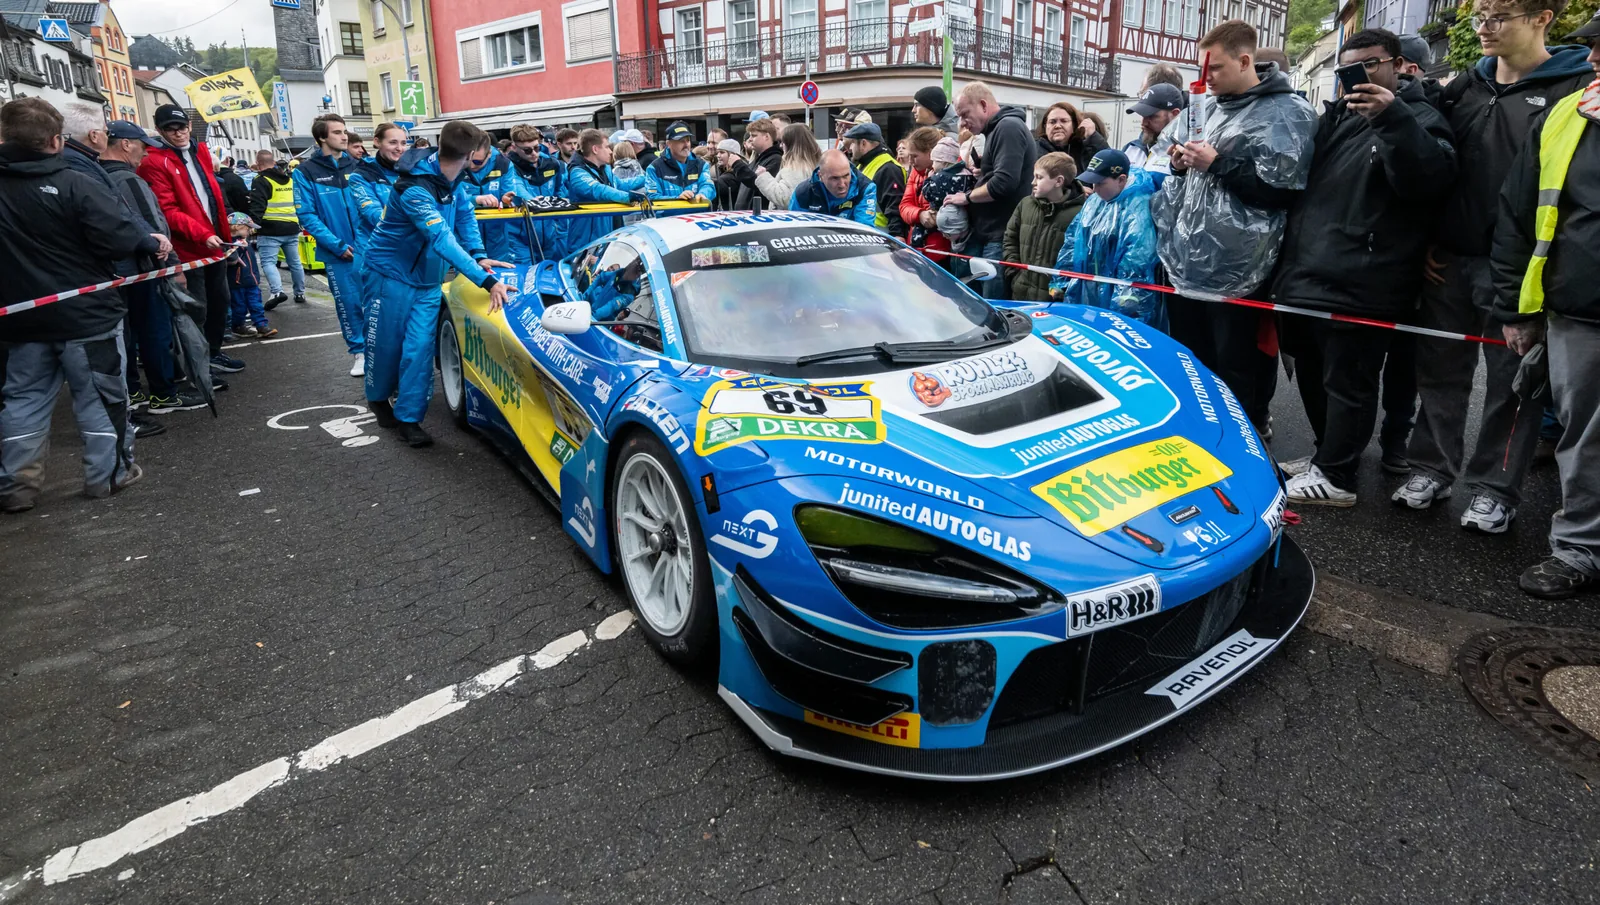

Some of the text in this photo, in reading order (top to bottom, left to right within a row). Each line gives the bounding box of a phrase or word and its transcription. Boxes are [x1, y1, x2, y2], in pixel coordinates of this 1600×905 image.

[280, 106, 289, 130] Bank
[770, 233, 884, 249] GRAN TURISMO
[654, 287, 677, 345] junitedAUTOGLAS
[1130, 327, 1152, 349] Cam
[463, 314, 521, 410] Bitburger
[937, 351, 1028, 387] RÜHL24
[1042, 324, 1156, 392] pyroland
[762, 390, 828, 415] 69
[952, 370, 1035, 402] SPORTNAHRUNG
[1176, 352, 1219, 424] MOTORWORLD
[756, 418, 869, 440] DEKRA
[1010, 413, 1140, 466] junitedAUTOGLAS
[804, 446, 984, 511] MOTORWORLD
[1046, 456, 1201, 523] Bitburger
[837, 482, 1032, 562] junitedAUTOGLAS
[1071, 593, 1128, 631] H&R
[1166, 637, 1258, 696] RAVENOL
